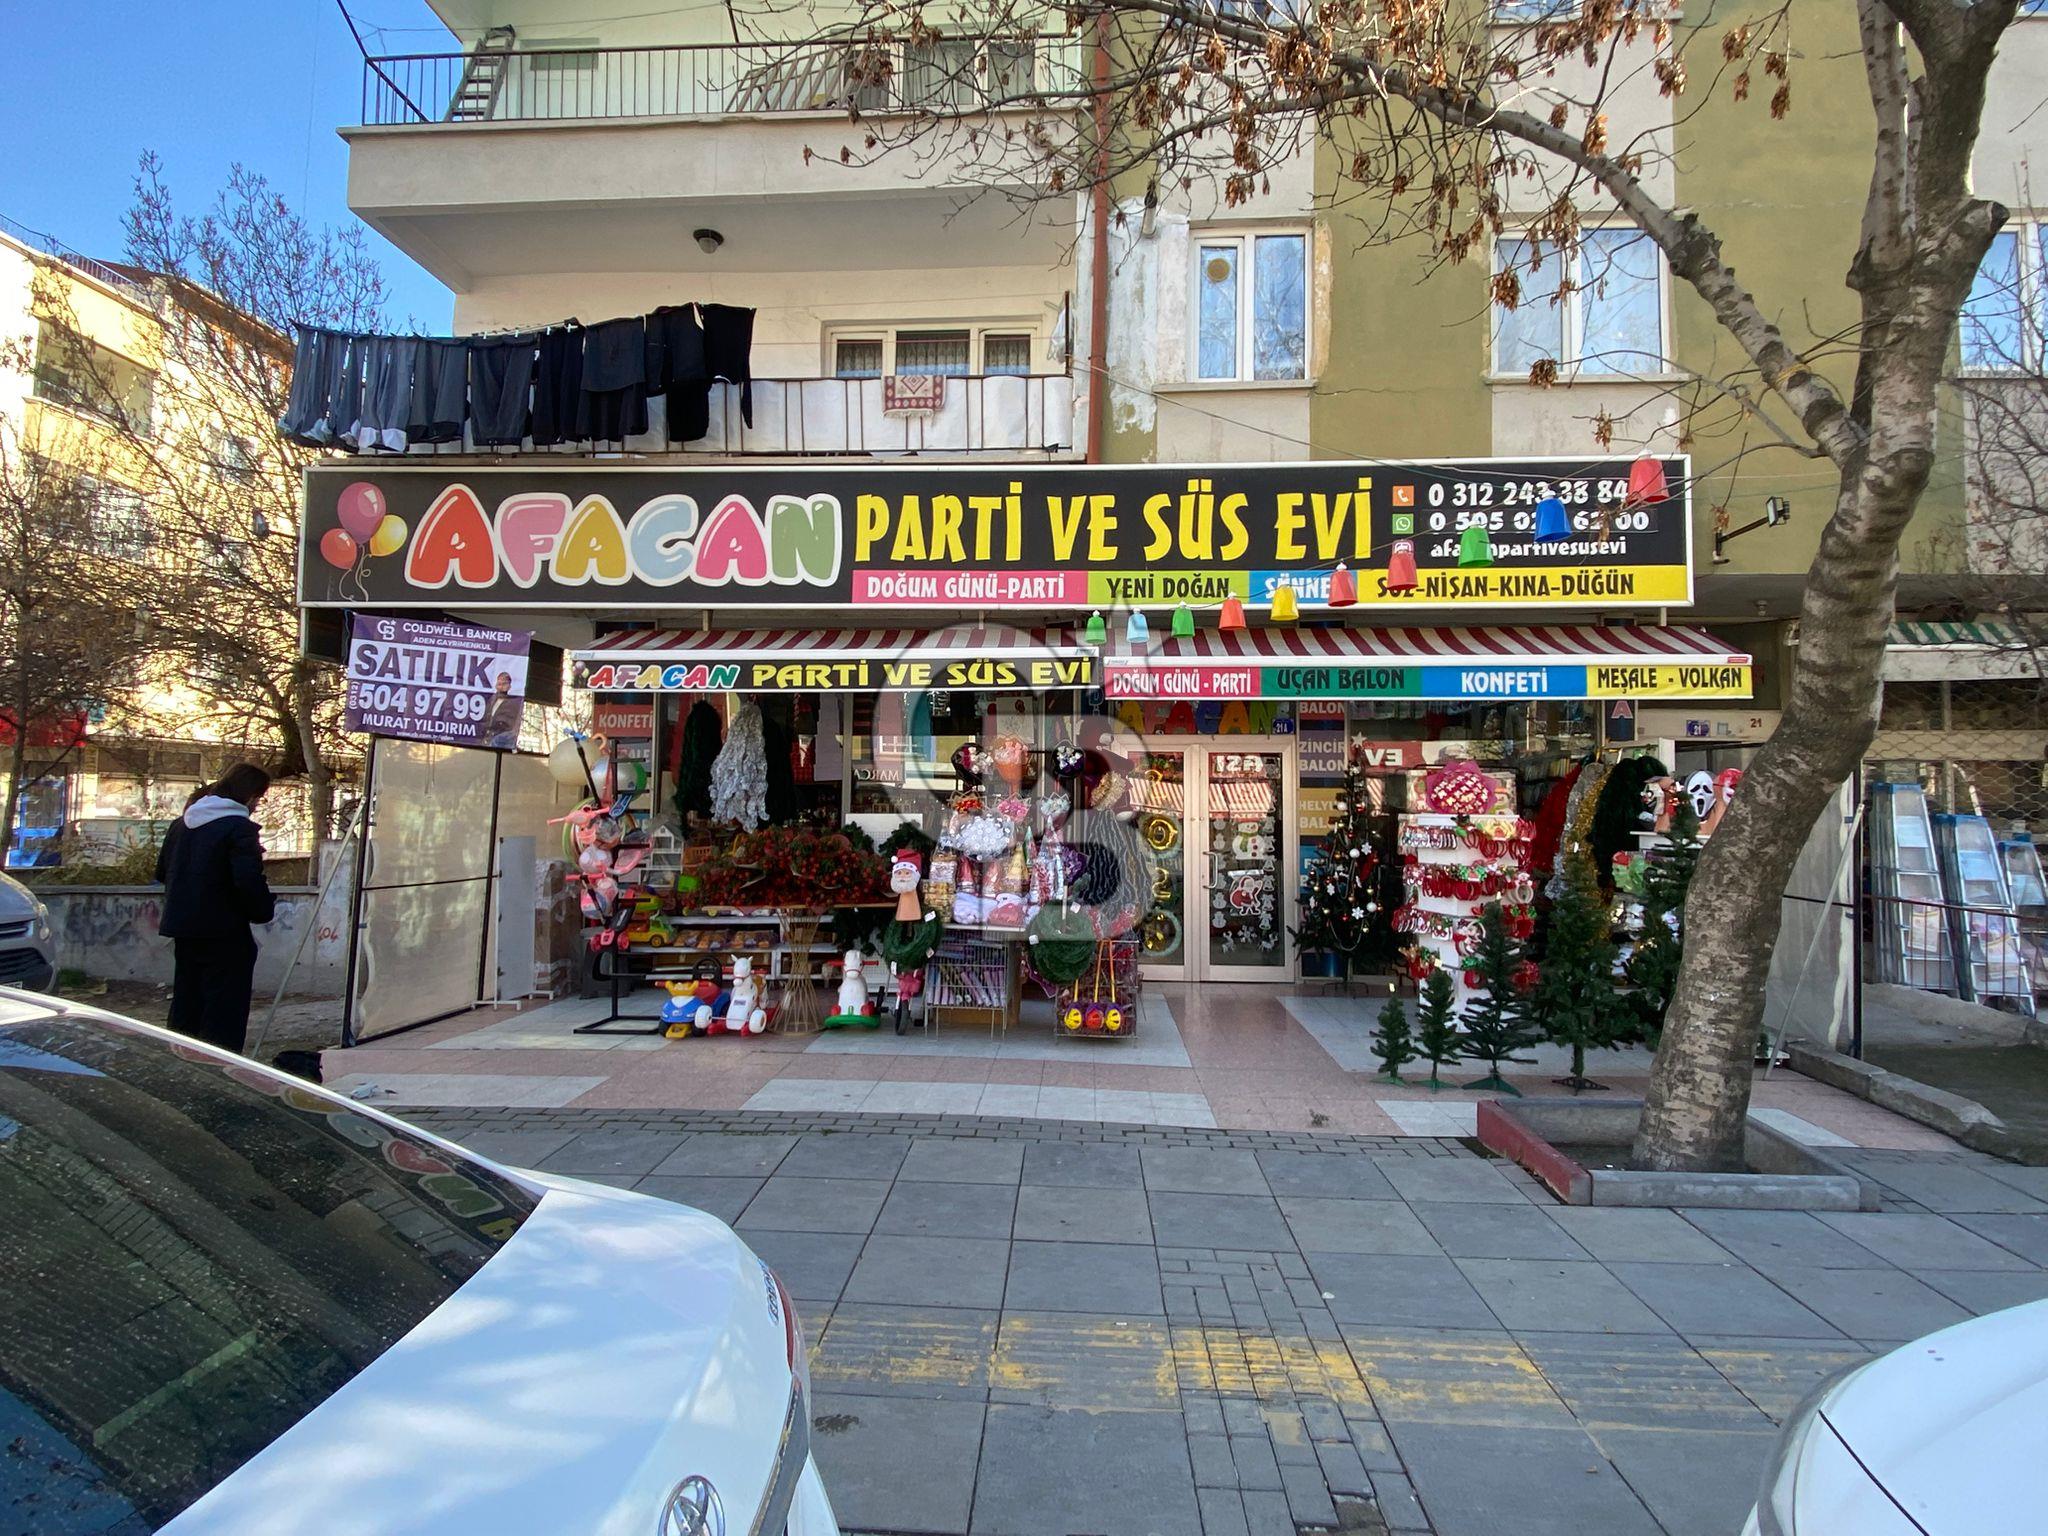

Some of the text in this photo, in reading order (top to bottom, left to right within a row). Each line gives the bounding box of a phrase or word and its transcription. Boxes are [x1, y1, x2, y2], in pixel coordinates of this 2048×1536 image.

[1428, 480, 1629, 506] 0 312 243 38 84
[404, 477, 1372, 588] AFACAN PARTİ VE SÜS EVİ
[1429, 511, 1446, 531] 0
[1615, 511, 1649, 530] 00
[867, 574, 1065, 599] DOĞUM GÜNÜ-PARTİ
[1106, 572, 1230, 599] YENİ DOĞAN
[403, 622, 512, 642] COLDWELL BANKER
[413, 636, 435, 645] ADEN
[355, 644, 495, 689] SATILIK
[587, 656, 1092, 688] AFACAN PARTİ VE SÜS EVİ
[1112, 669, 1160, 694] DOĞUM
[1163, 670, 1200, 693] GÜNÜ
[1212, 668, 1251, 695] PARTİ
[1277, 668, 1405, 695] UÇAN BALON
[1461, 667, 1548, 695] KONFETİ
[1597, 668, 1657, 694] MEŞALE
[1678, 667, 1742, 690] VOLKAN
[359, 683, 486, 721] 504 97 99
[362, 713, 476, 737] MURAT YILDIRIM
[1750, 718, 1762, 728] 21
